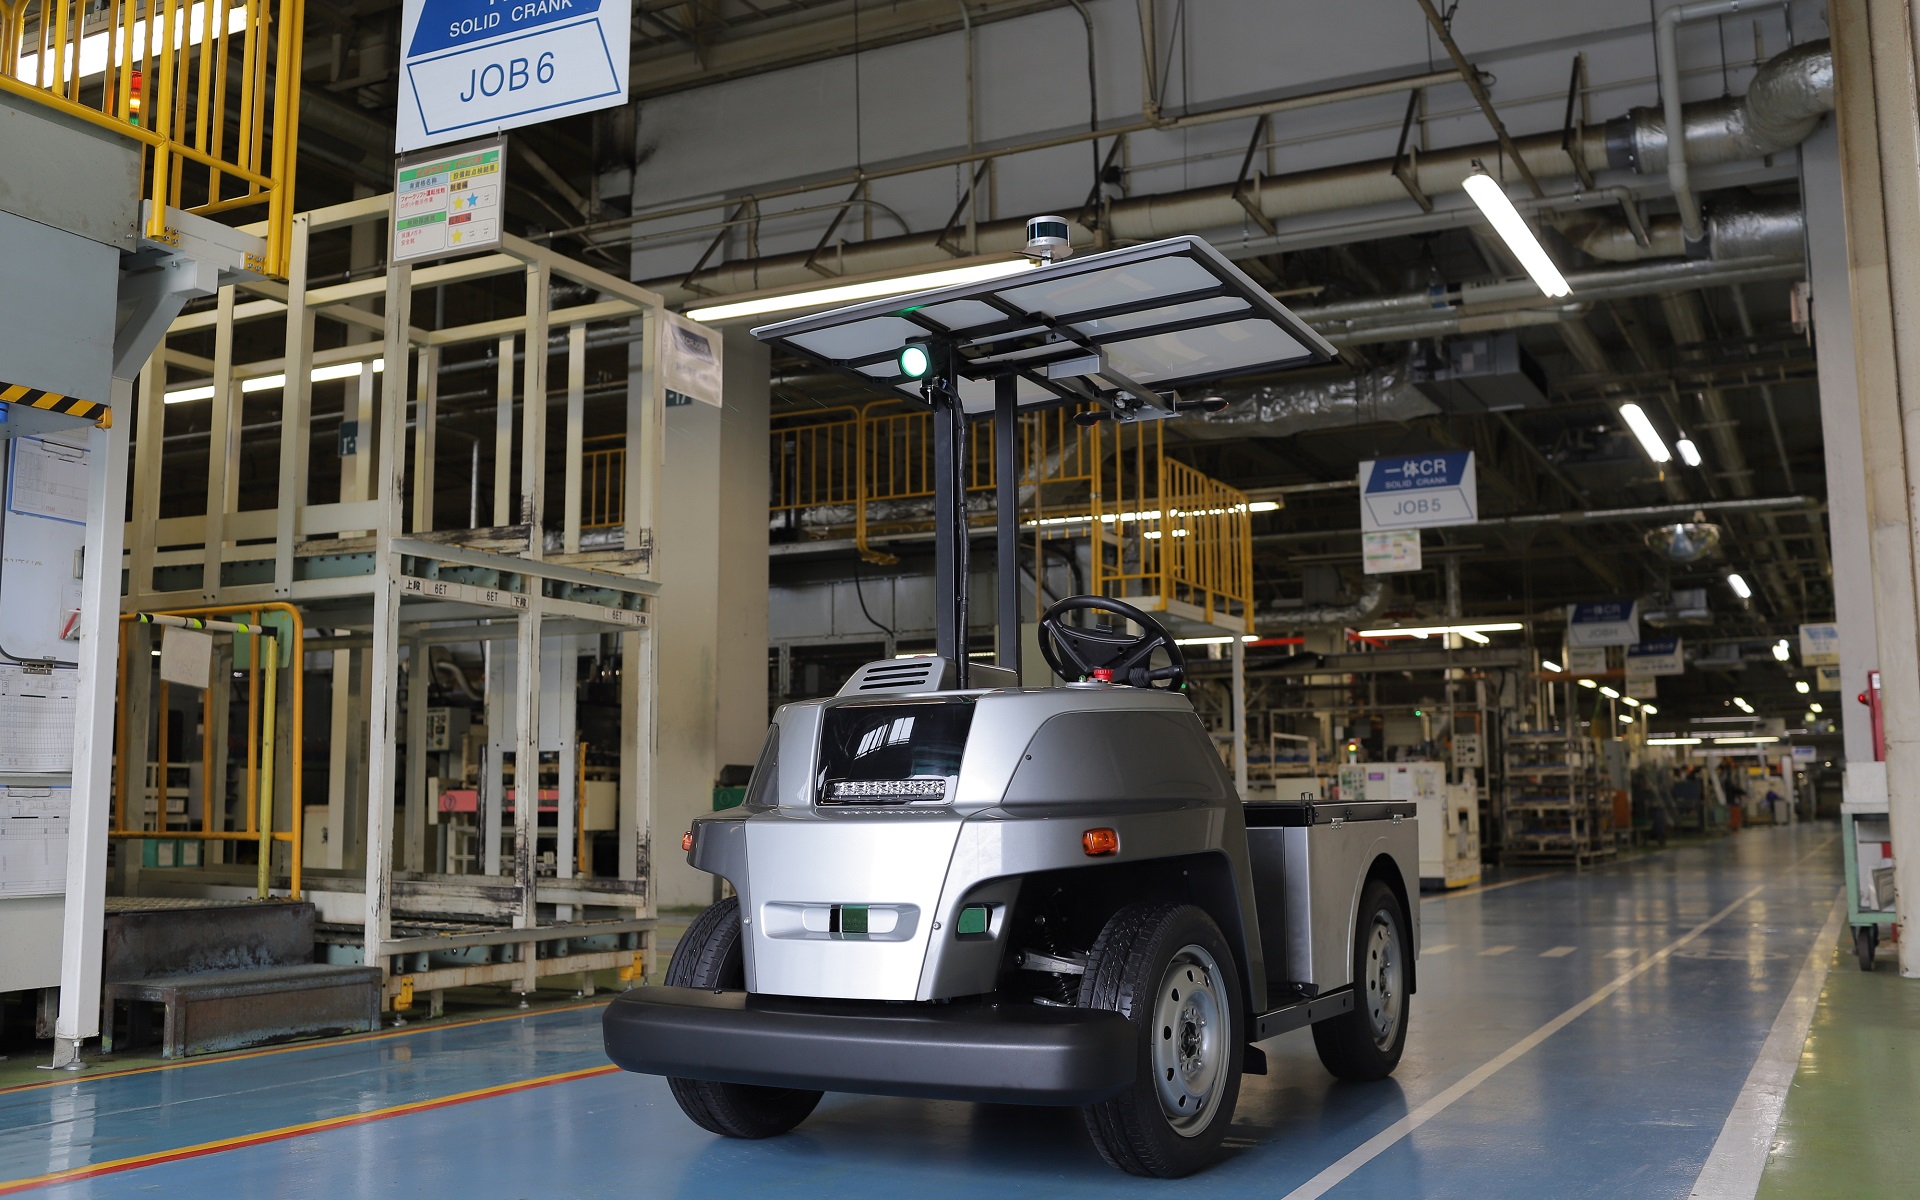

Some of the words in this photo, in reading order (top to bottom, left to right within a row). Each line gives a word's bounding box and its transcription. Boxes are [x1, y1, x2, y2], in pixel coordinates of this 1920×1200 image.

[449, 12, 500, 37] SOLID
[511, 0, 573, 22] CRANK
[1384, 458, 1447, 478] 一体CR
[1385, 479, 1412, 489] SOLID
[1416, 476, 1448, 487] CRANK
[405, 579, 421, 591] 上段
[434, 583, 447, 595] 6ET
[486, 591, 498, 602] 6ET
[513, 596, 526, 607] 下段
[612, 610, 622, 620] 6ET
[635, 614, 646, 624] 下段
